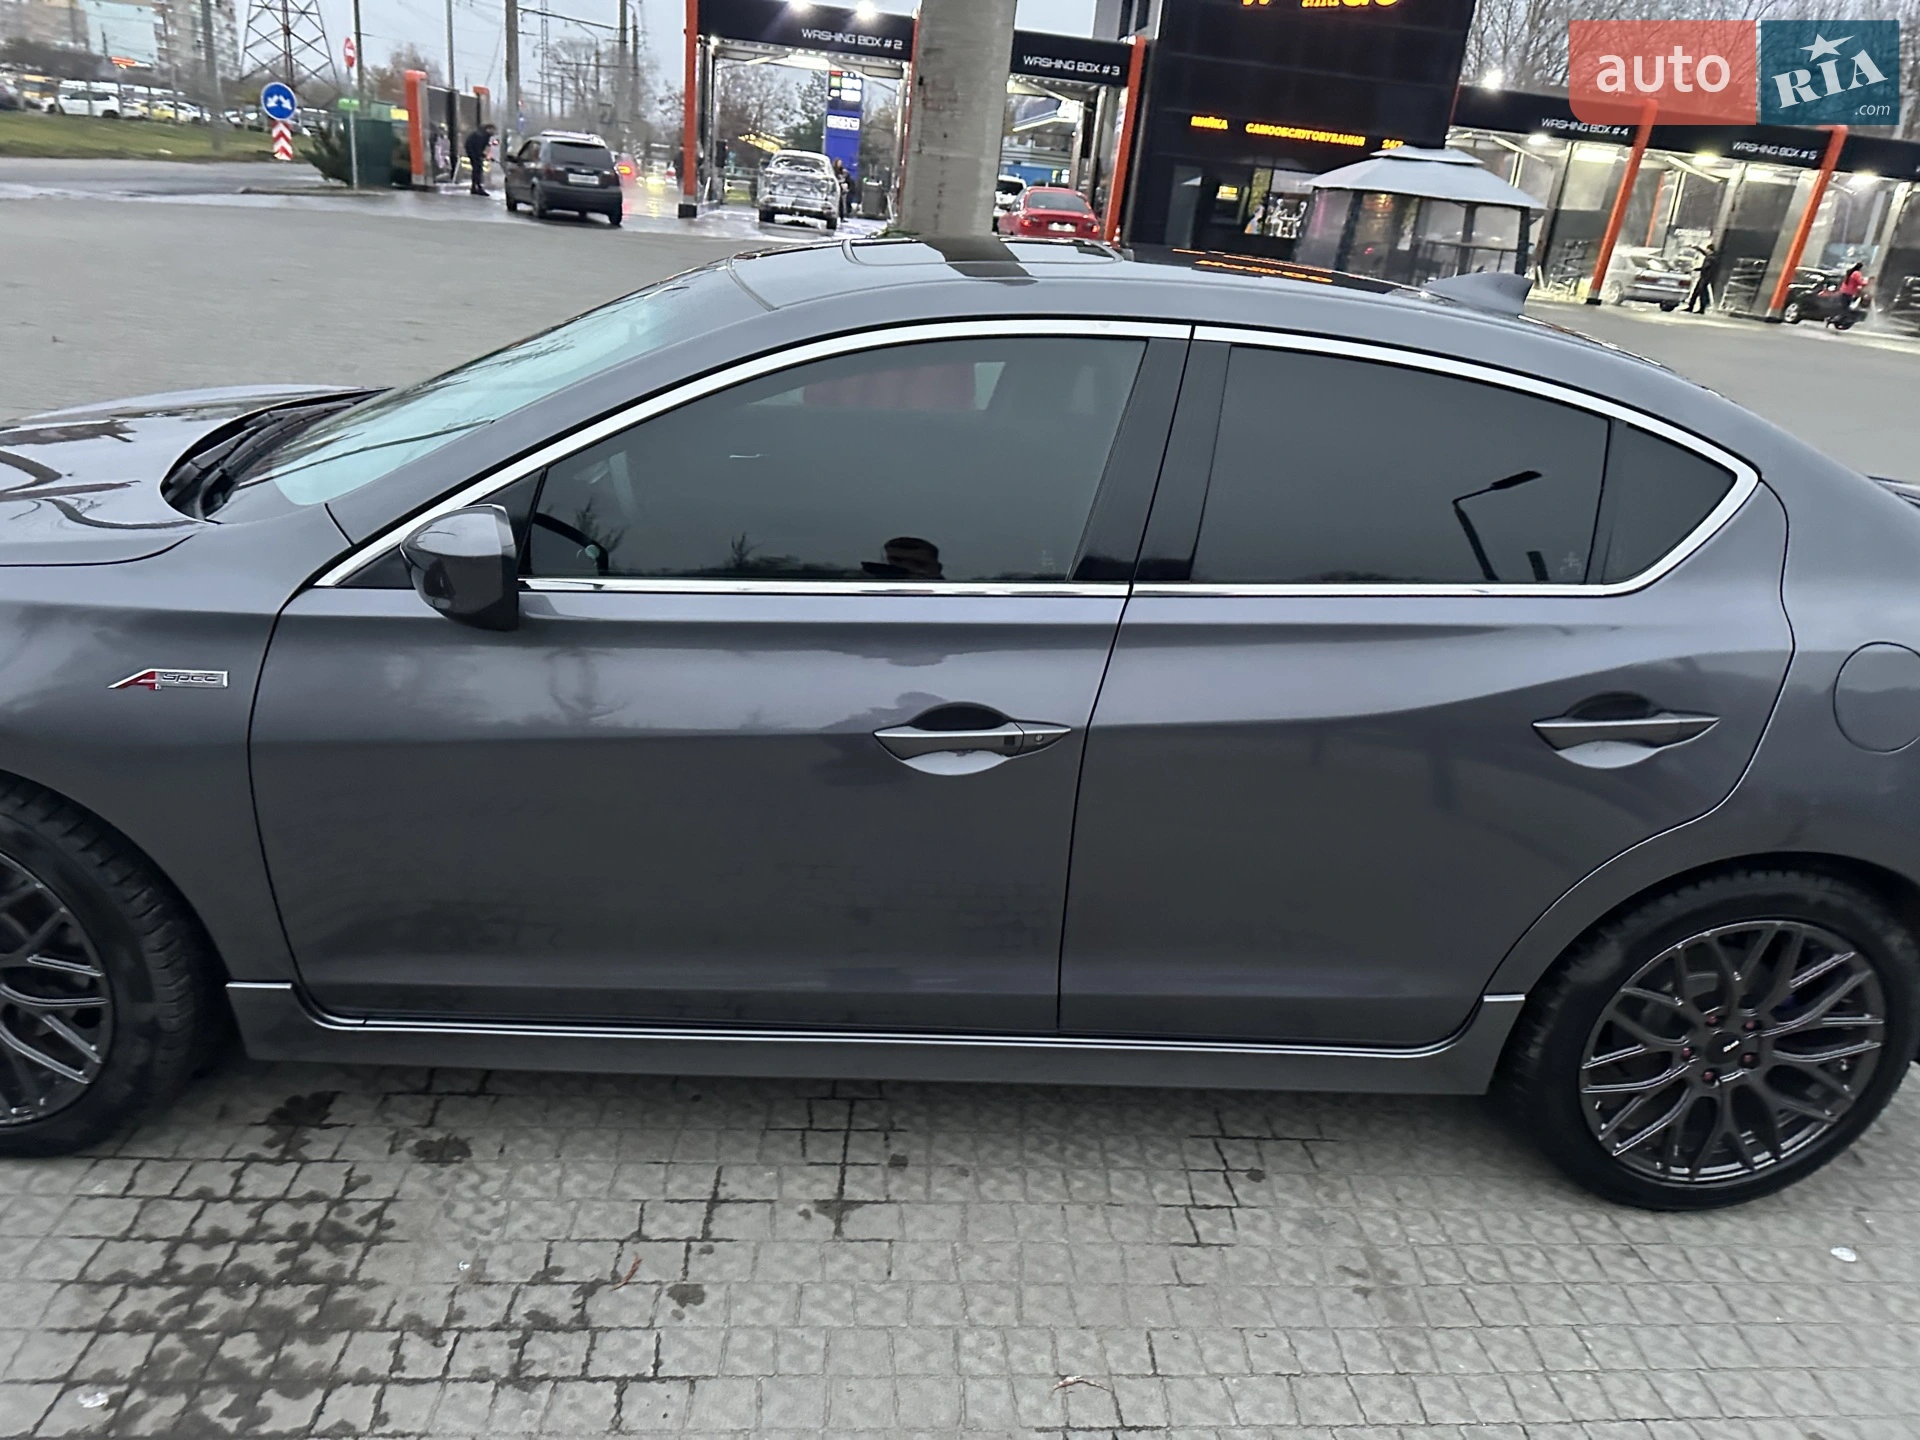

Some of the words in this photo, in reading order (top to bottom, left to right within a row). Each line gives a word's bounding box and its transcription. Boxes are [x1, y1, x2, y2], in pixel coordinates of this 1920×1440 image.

[801, 28, 856, 44] WASHING
[857, 34, 882, 47] BOX
[1023, 55, 1076, 71] WASHING
[1076, 61, 1100, 73] BOX
[1541, 118, 1589, 132] WASHING
[1589, 124, 1611, 134] BOX
[1732, 141, 1779, 155] WASHING
[1779, 146, 1800, 157] BOX
